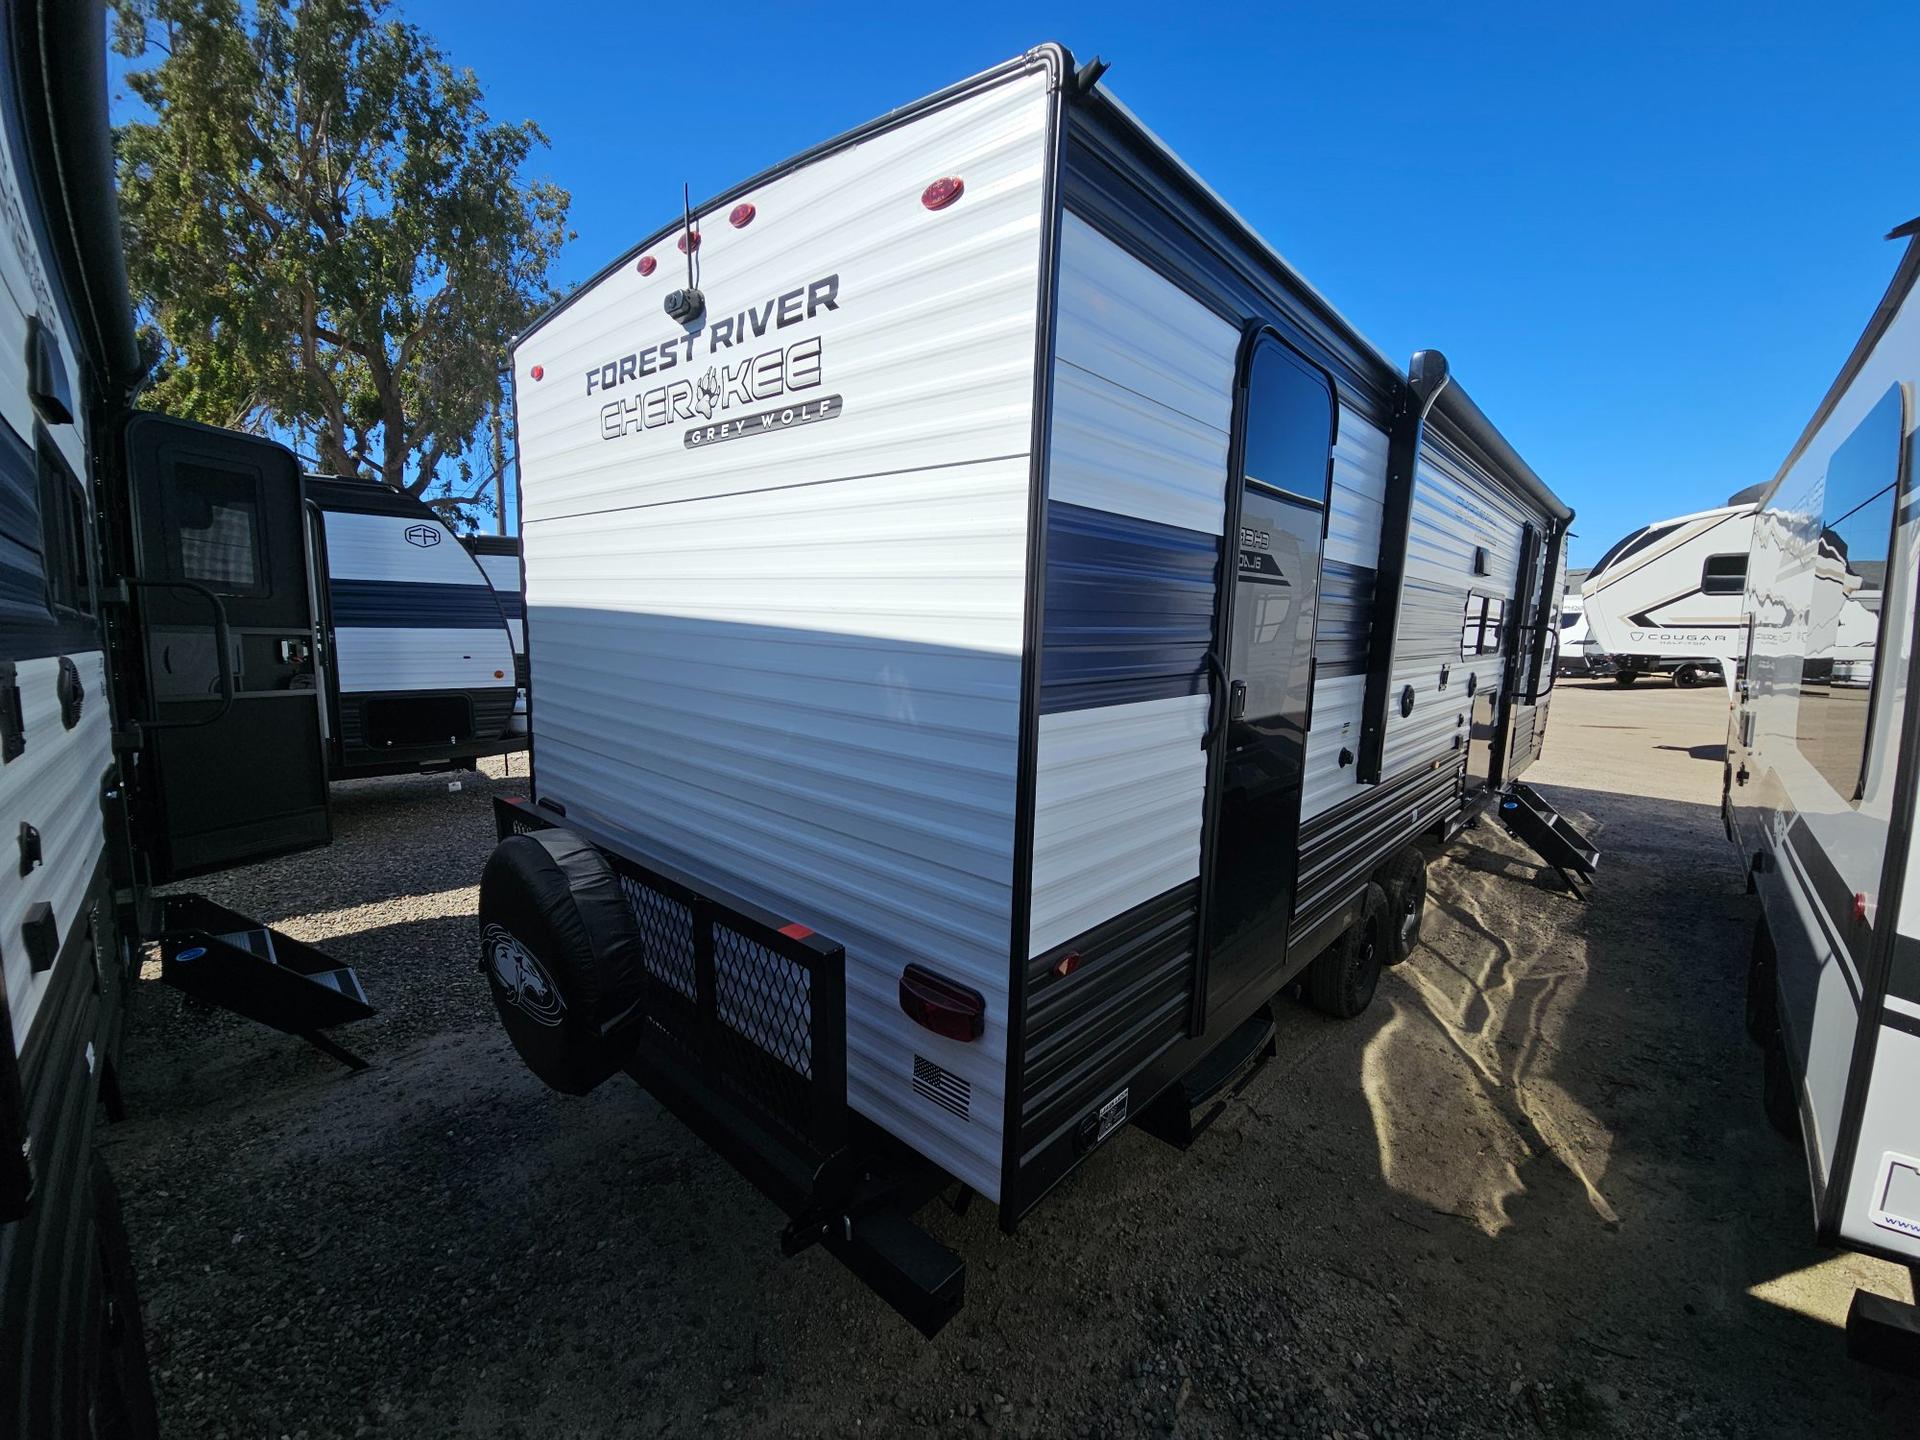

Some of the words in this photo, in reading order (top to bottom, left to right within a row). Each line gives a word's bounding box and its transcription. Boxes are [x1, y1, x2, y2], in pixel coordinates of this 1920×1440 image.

[586, 332, 704, 396] FOREST
[709, 273, 840, 354] RIVER
[691, 421, 745, 443] GREY
[761, 400, 831, 428] WOLF
[408, 527, 437, 545] FR
[1648, 633, 1727, 641] COUGAR
